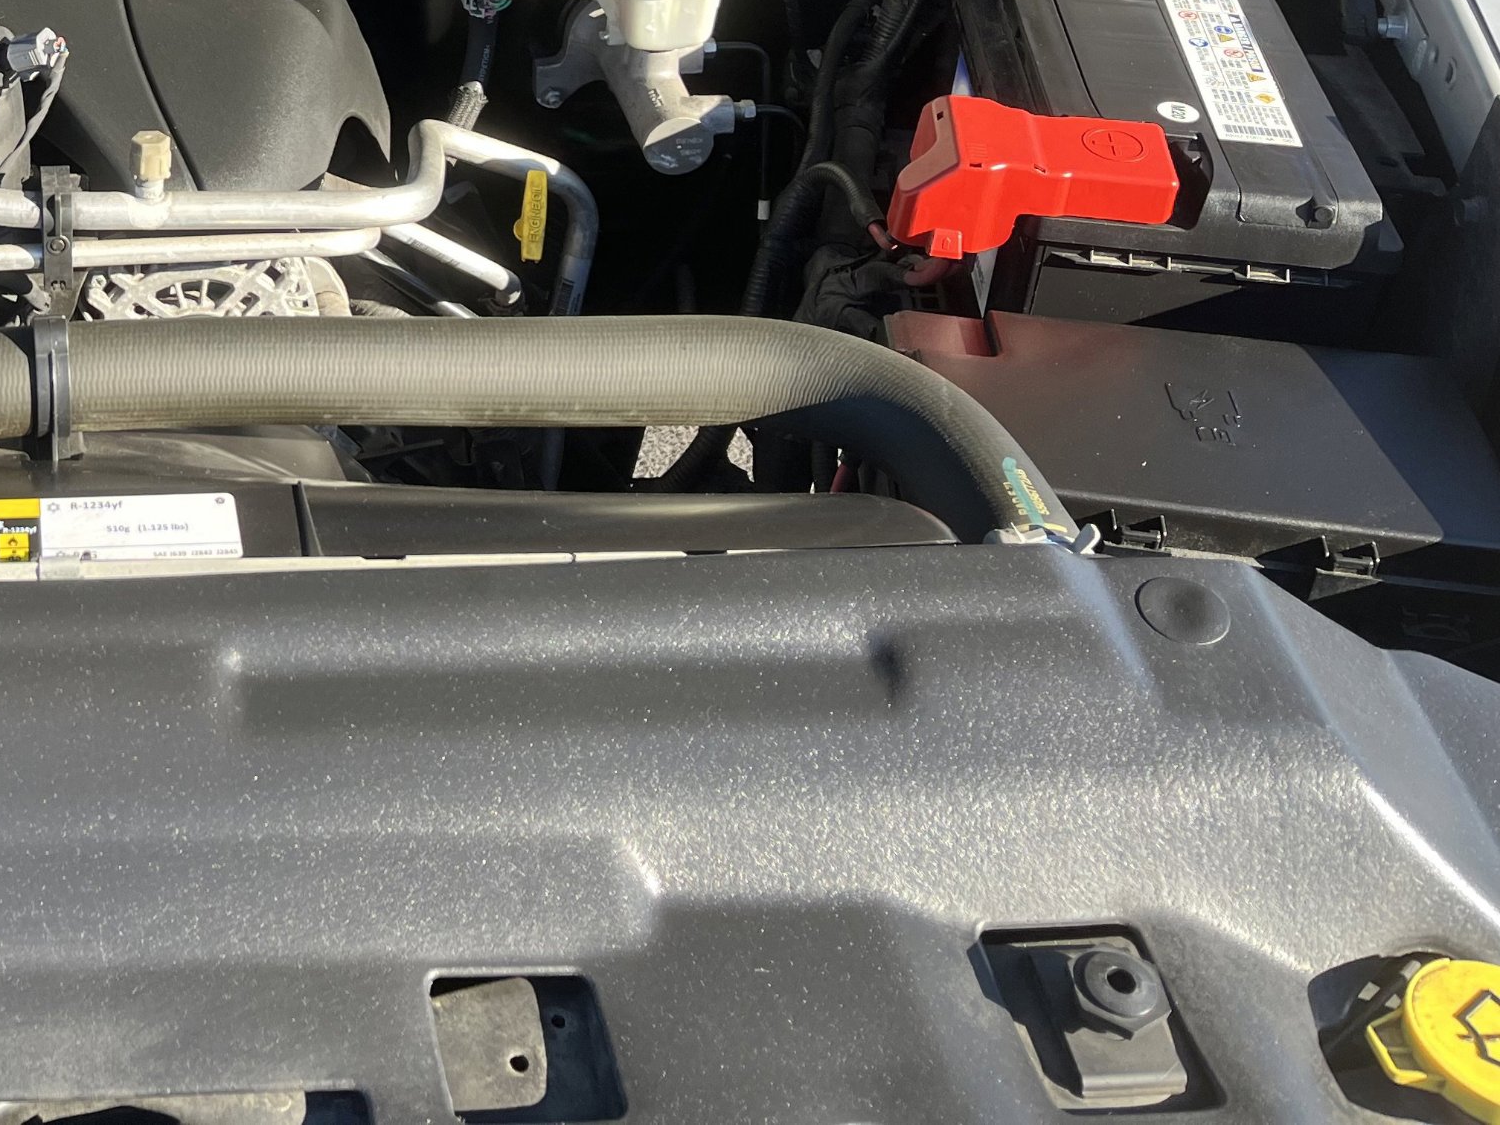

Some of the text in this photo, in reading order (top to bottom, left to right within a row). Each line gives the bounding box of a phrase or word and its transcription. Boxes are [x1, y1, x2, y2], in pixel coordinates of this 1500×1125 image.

[1171, 105, 1187, 120] M20
[528, 185, 542, 243] ENGINE OIL
[70, 500, 123, 511] R-1234yf
[106, 522, 189, 534] 510g (1.125 lbs)
